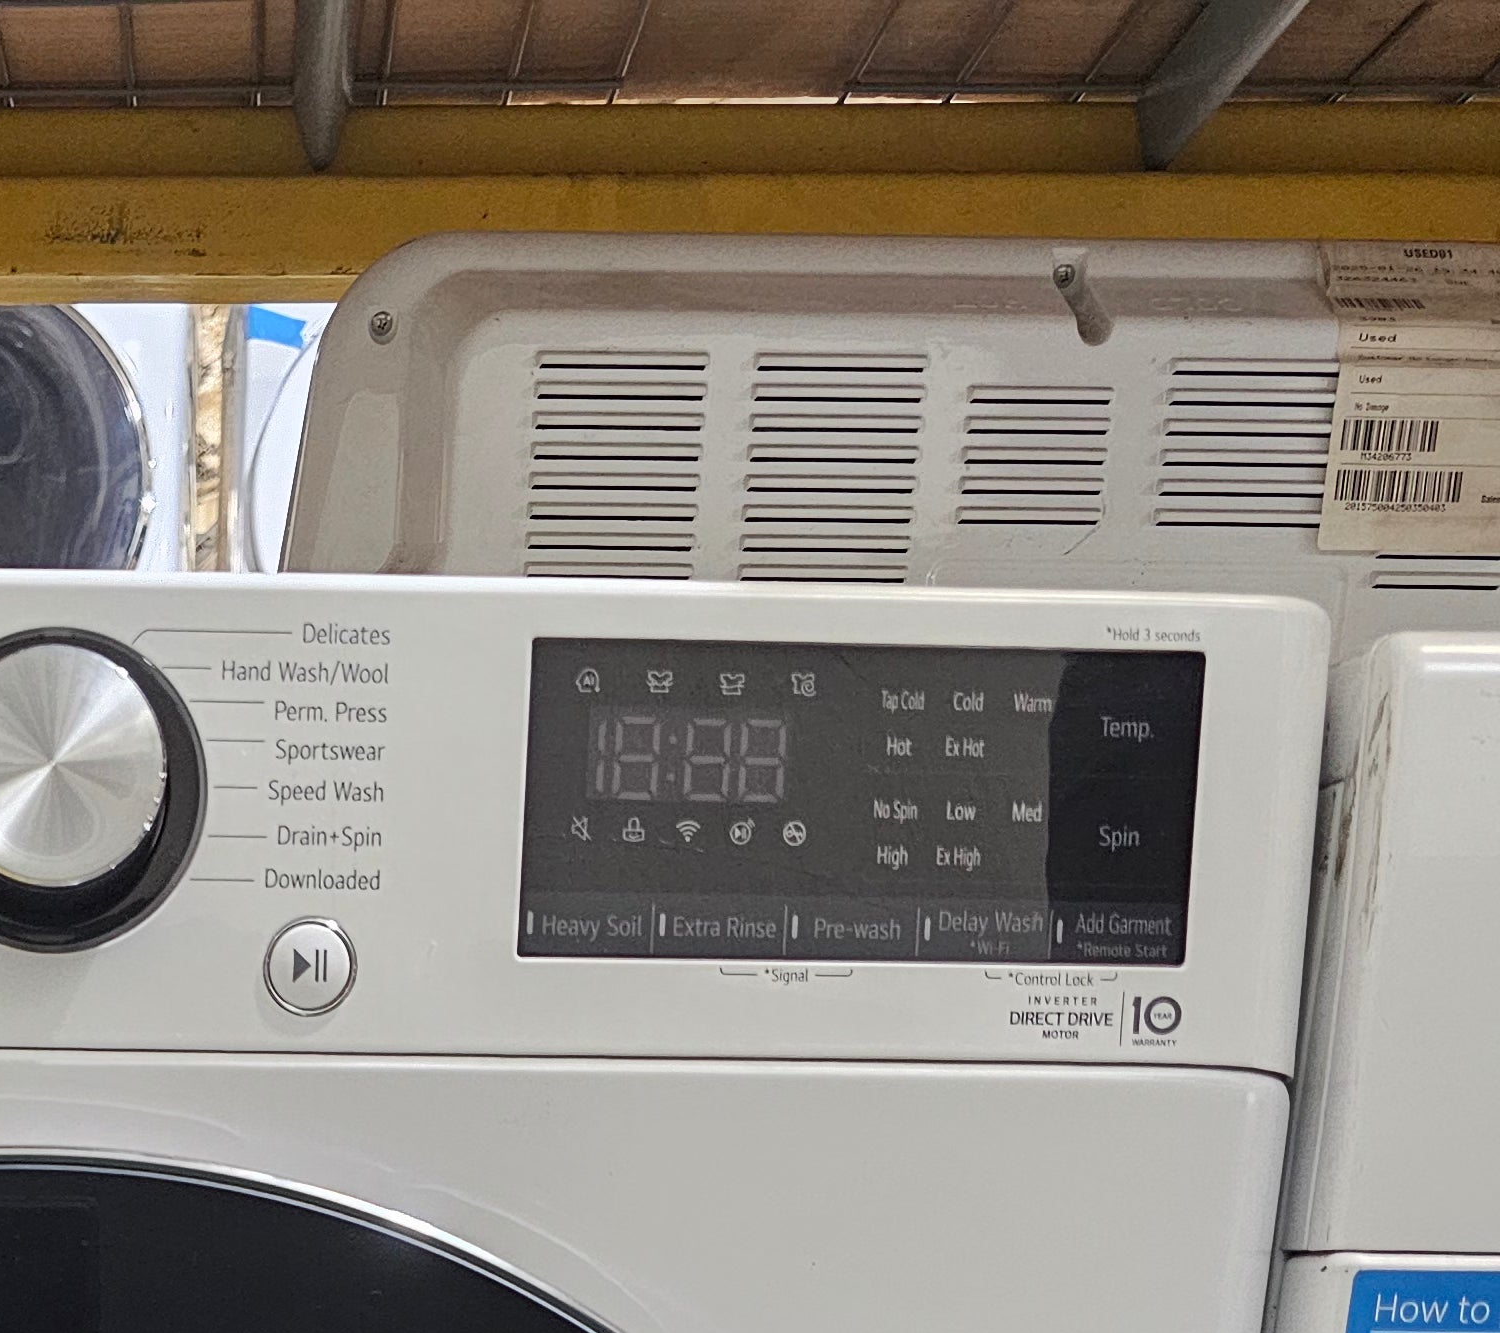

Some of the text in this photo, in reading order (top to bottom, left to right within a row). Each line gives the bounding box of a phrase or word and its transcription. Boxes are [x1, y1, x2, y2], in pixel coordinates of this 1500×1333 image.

[1358, 332, 1398, 343] Used
[1358, 374, 1383, 384] Used
[302, 621, 392, 645] Delicates
[1144, 627, 1151, 641] 3
[1154, 628, 1202, 642] seconds
[221, 660, 389, 686] Hand Wash/Wool
[274, 700, 388, 723] Perm. Press
[881, 689, 926, 714] Tap Cold
[953, 691, 985, 713] Cold
[1013, 692, 1053, 713] Warm
[1101, 715, 1155, 744] Temp.
[275, 738, 387, 765] Sportswear
[886, 735, 913, 757] Hot
[944, 735, 985, 758] Ex Hot
[268, 779, 385, 806] Speed Wash
[873, 799, 919, 825] No Spin
[946, 801, 977, 821] Low
[1011, 801, 1043, 823] Med
[277, 825, 383, 852] Drain+Spin
[1098, 825, 1141, 852] Spin
[876, 845, 909, 871] High
[936, 845, 982, 872] Ex High
[264, 868, 381, 891] Downloaded
[541, 913, 643, 942] Heavy Soil
[672, 915, 778, 939] Extra Rinse
[814, 917, 901, 941] Pre-wash
[938, 911, 1044, 937] Delay Wash
[1075, 912, 1173, 938] Add Garment
[1135, 942, 1169, 960] Start
[1065, 973, 1095, 988] Lock
[1027, 995, 1098, 1006] INVERTER
[1009, 1010, 1114, 1027] DIRECT DRIVE
[1131, 996, 1183, 1035] 10
[1041, 1030, 1080, 1040] MOTOR
[1131, 1038, 1178, 1047] WARRANTY
[1374, 1292, 1491, 1325] How to
